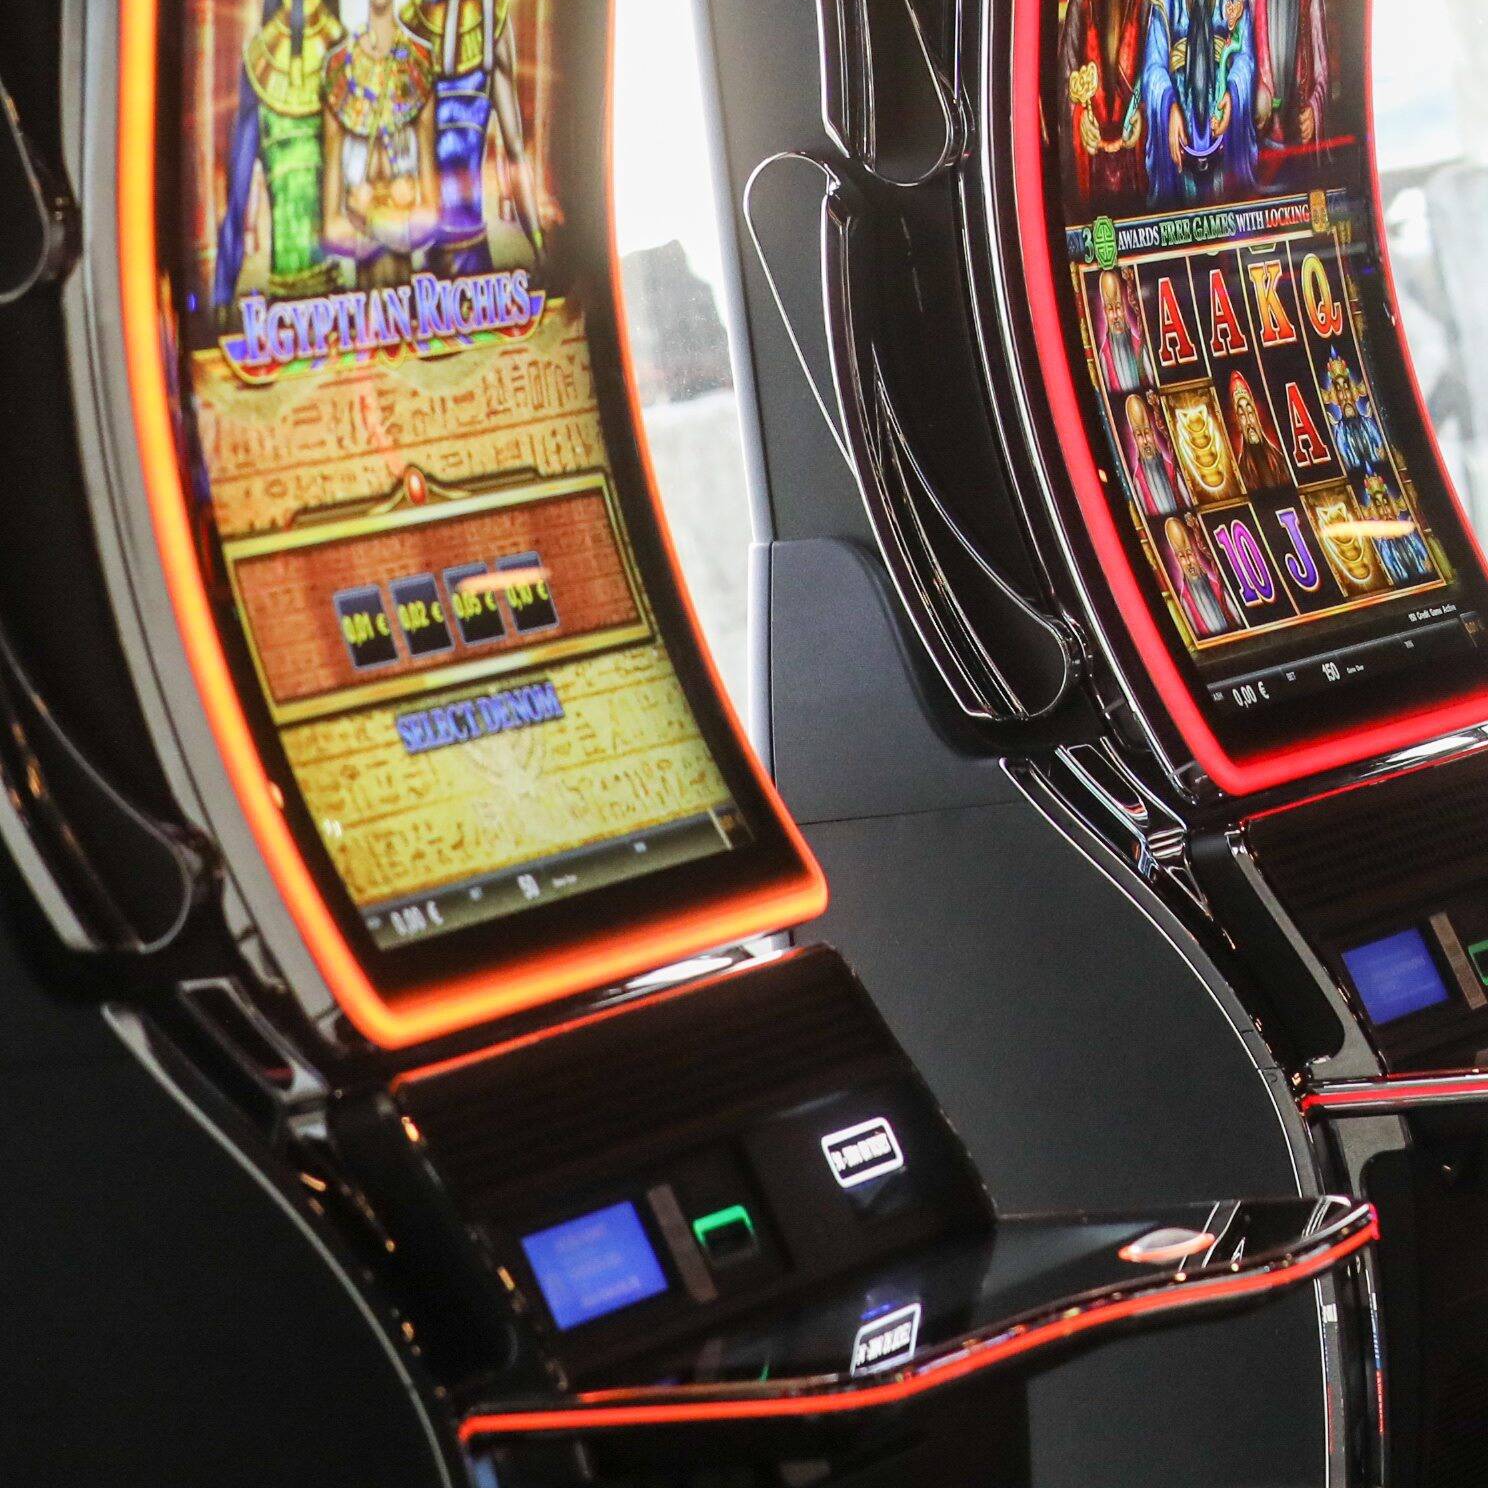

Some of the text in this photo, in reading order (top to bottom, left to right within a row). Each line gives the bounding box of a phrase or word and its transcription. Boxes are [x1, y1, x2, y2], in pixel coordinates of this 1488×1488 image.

[1083, 227, 1094, 263] 3
[1118, 225, 1160, 251] AWARDS
[1159, 220, 1191, 247] FREE
[1192, 211, 1236, 240] GAMES
[1236, 210, 1264, 233] WITH
[1265, 204, 1310, 229] LOCKING
[239, 269, 533, 364] EGYPTIAN RICHES
[1158, 276, 1195, 367] A
[1209, 268, 1248, 358] A
[1248, 261, 1295, 349] K
[1301, 253, 1342, 338] Q
[1284, 382, 1331, 467] A
[1216, 518, 1275, 608] 10
[1275, 509, 1319, 590] J
[1232, 684, 1257, 709] 0,00
[1260, 680, 1270, 700] €
[1321, 661, 1340, 682] 150
[397, 680, 564, 754] SELECT DENOM
